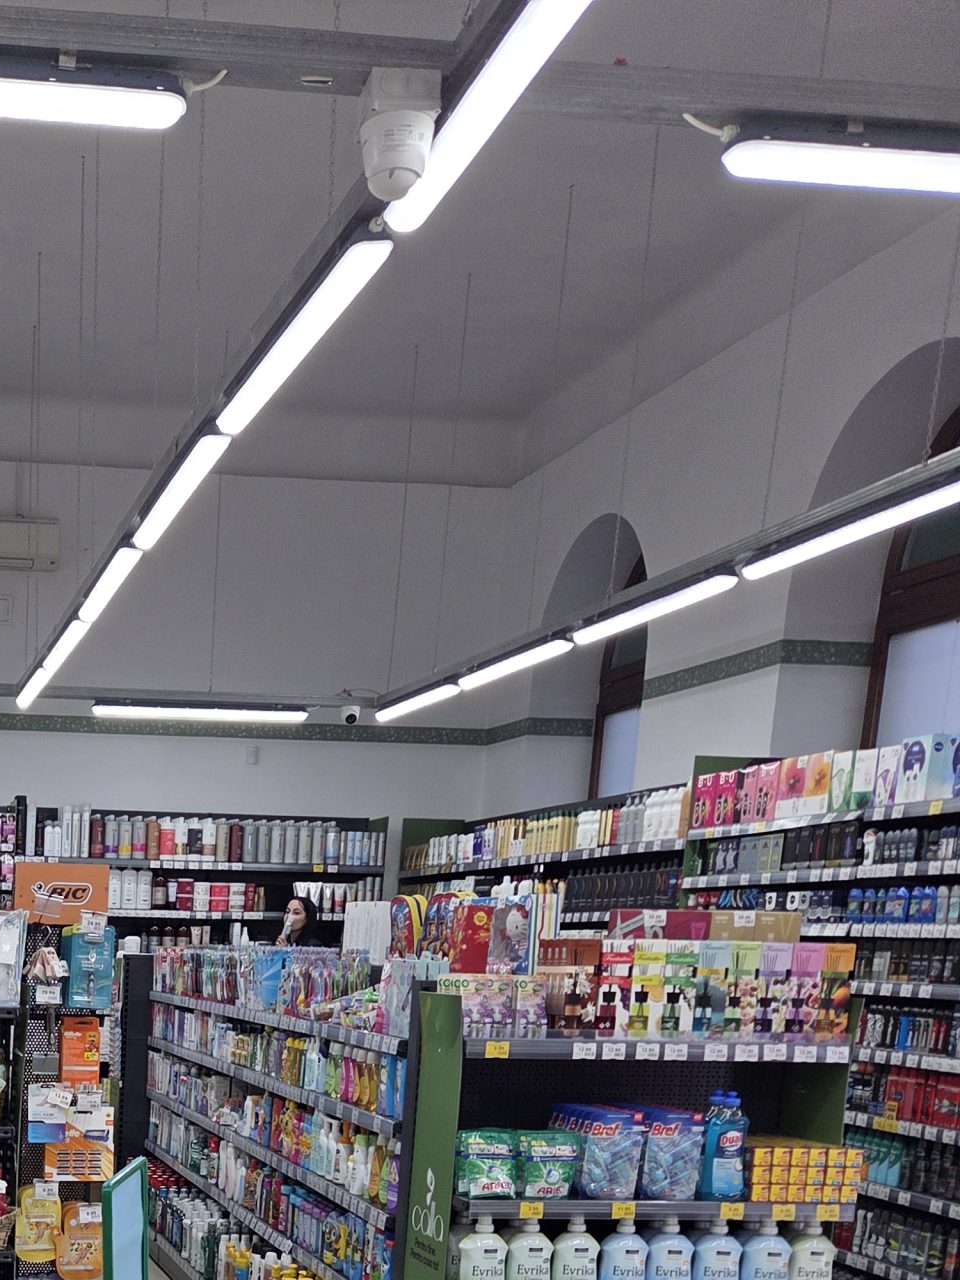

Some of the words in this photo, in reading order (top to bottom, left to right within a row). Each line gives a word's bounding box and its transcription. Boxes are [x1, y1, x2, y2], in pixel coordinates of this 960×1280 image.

[591, 1122, 620, 1137] Bref
[651, 1122, 681, 1137] Bref
[471, 1266, 503, 1277] Evrika
[517, 1264, 549, 1276] Evrika
[562, 1264, 594, 1276] Evrika
[613, 1265, 644, 1277] Evrika
[655, 1266, 689, 1277] Evrika
[704, 1266, 737, 1278] Evrika
[754, 1267, 787, 1279] Evrika
[797, 1266, 829, 1279] Evrika
